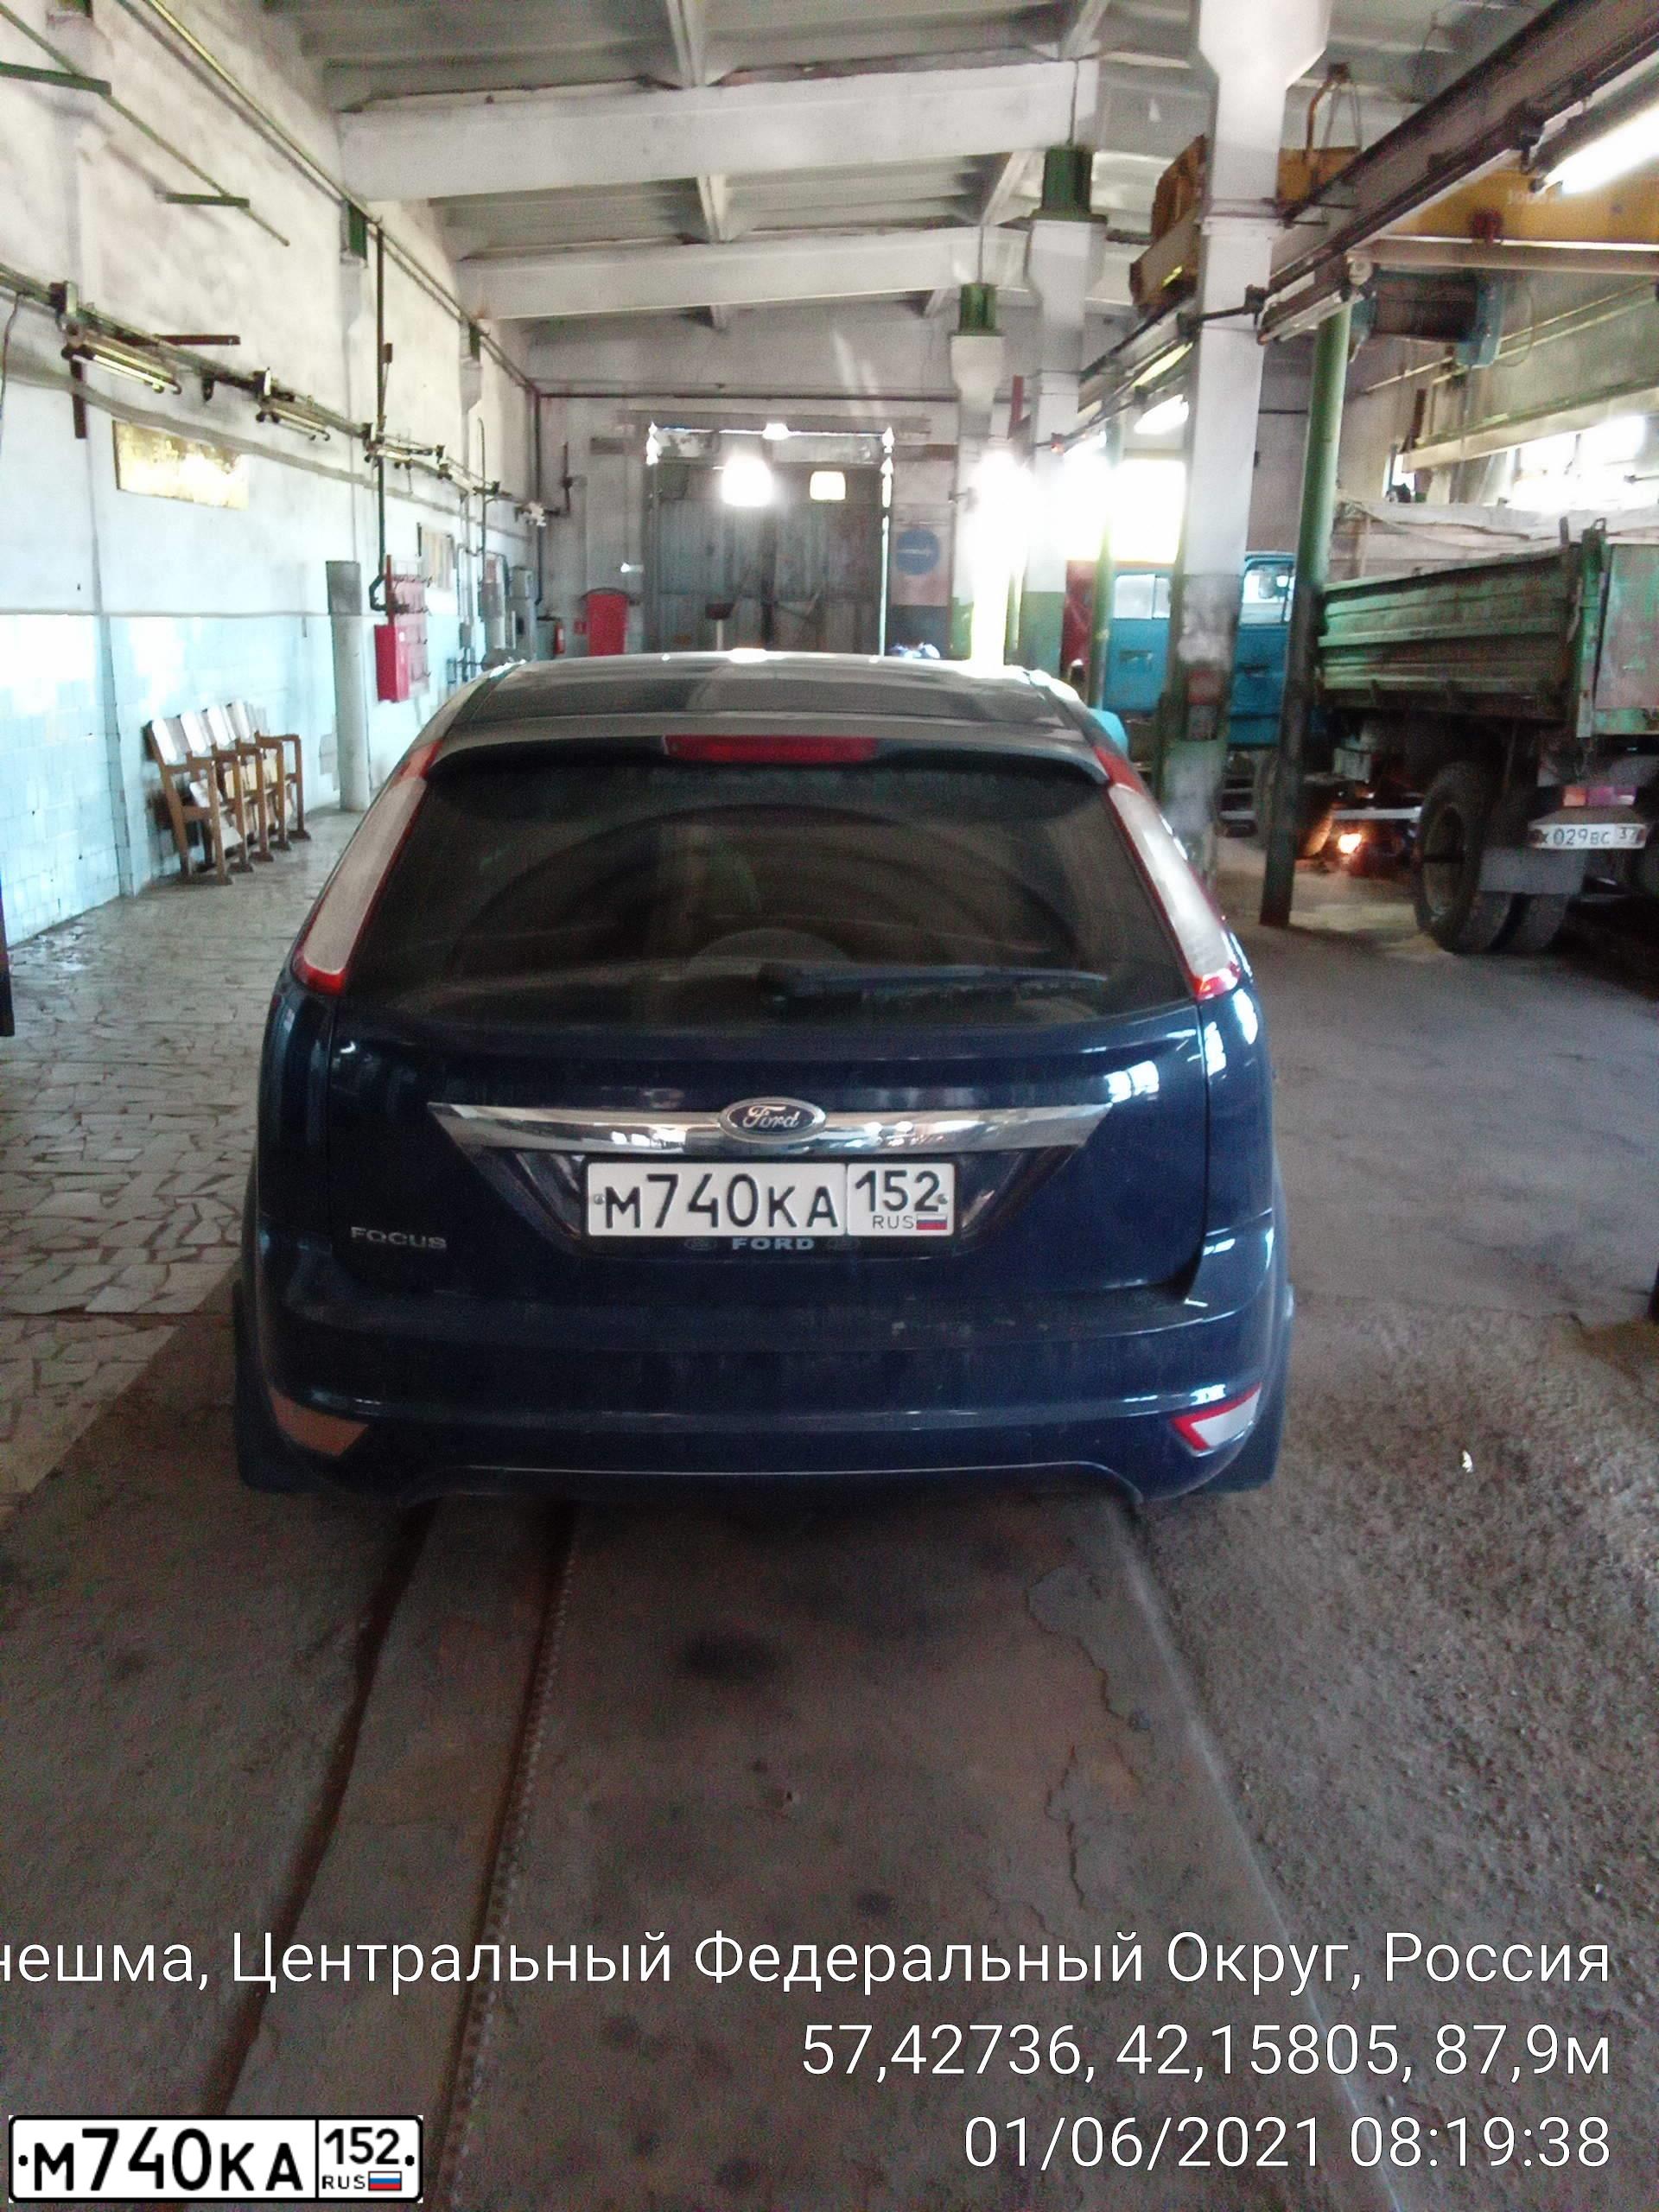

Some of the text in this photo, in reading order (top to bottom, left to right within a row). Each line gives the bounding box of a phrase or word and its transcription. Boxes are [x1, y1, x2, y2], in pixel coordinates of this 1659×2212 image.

[742, 1104, 801, 1128] Ford
[854, 1169, 940, 1211] 152
[872, 1215, 914, 1230] RUS
[350, 1226, 447, 1249] FOCUS
[732, 1236, 815, 1251] FORD
